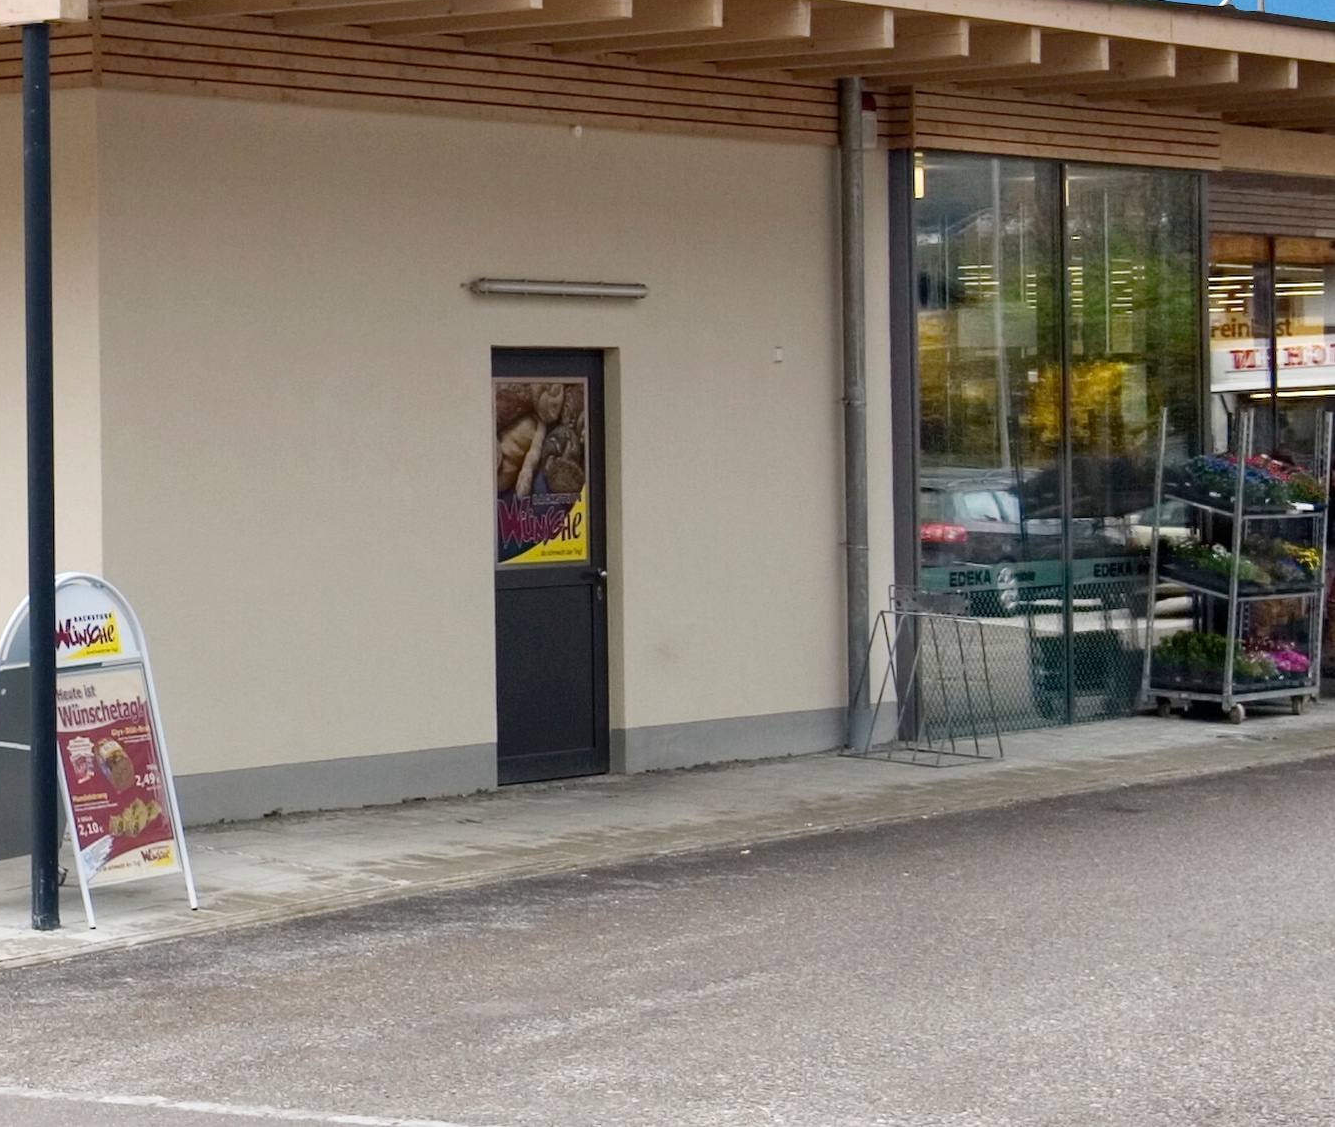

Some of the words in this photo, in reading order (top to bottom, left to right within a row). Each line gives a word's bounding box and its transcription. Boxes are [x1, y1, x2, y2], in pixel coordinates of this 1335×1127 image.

[1093, 561, 1132, 578] EDEKA
[949, 570, 992, 587] EDEKA
[83, 684, 97, 698] ist
[57, 696, 145, 728] Wünschetag!
